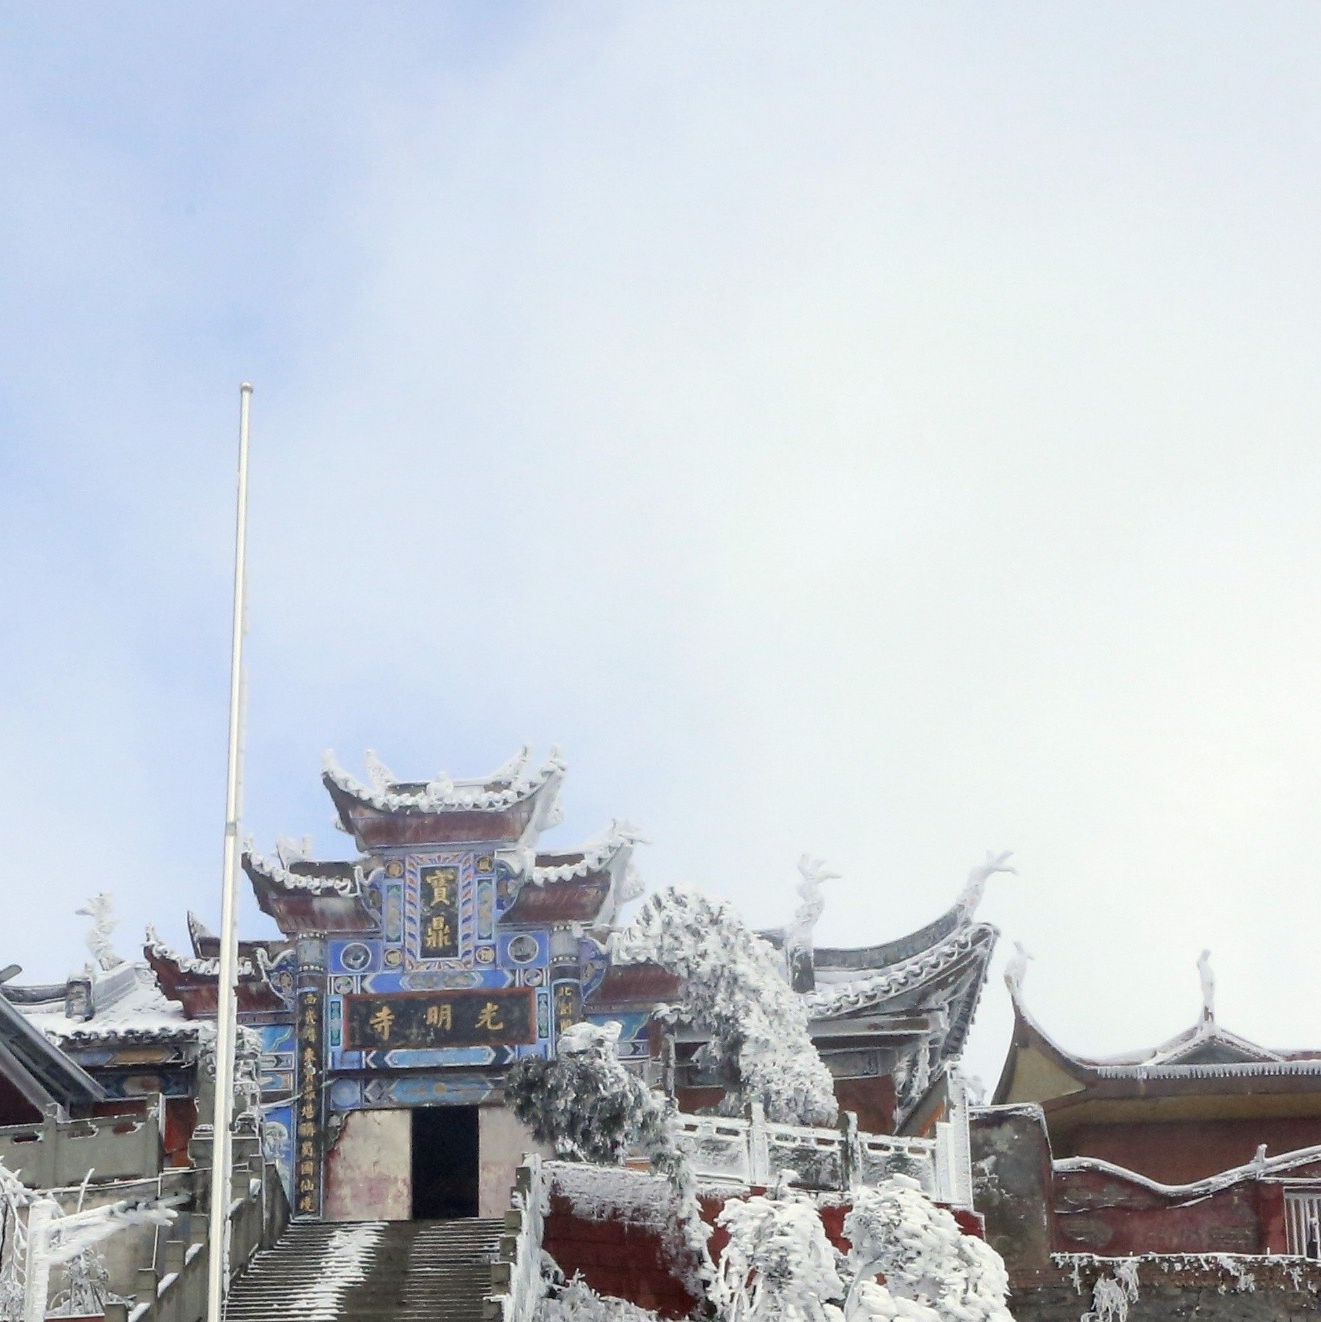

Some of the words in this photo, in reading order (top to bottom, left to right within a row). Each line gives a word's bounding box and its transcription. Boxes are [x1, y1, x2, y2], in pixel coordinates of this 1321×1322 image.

[424, 868, 456, 950] 寶鼎
[369, 1001, 504, 1041] 光明寺
